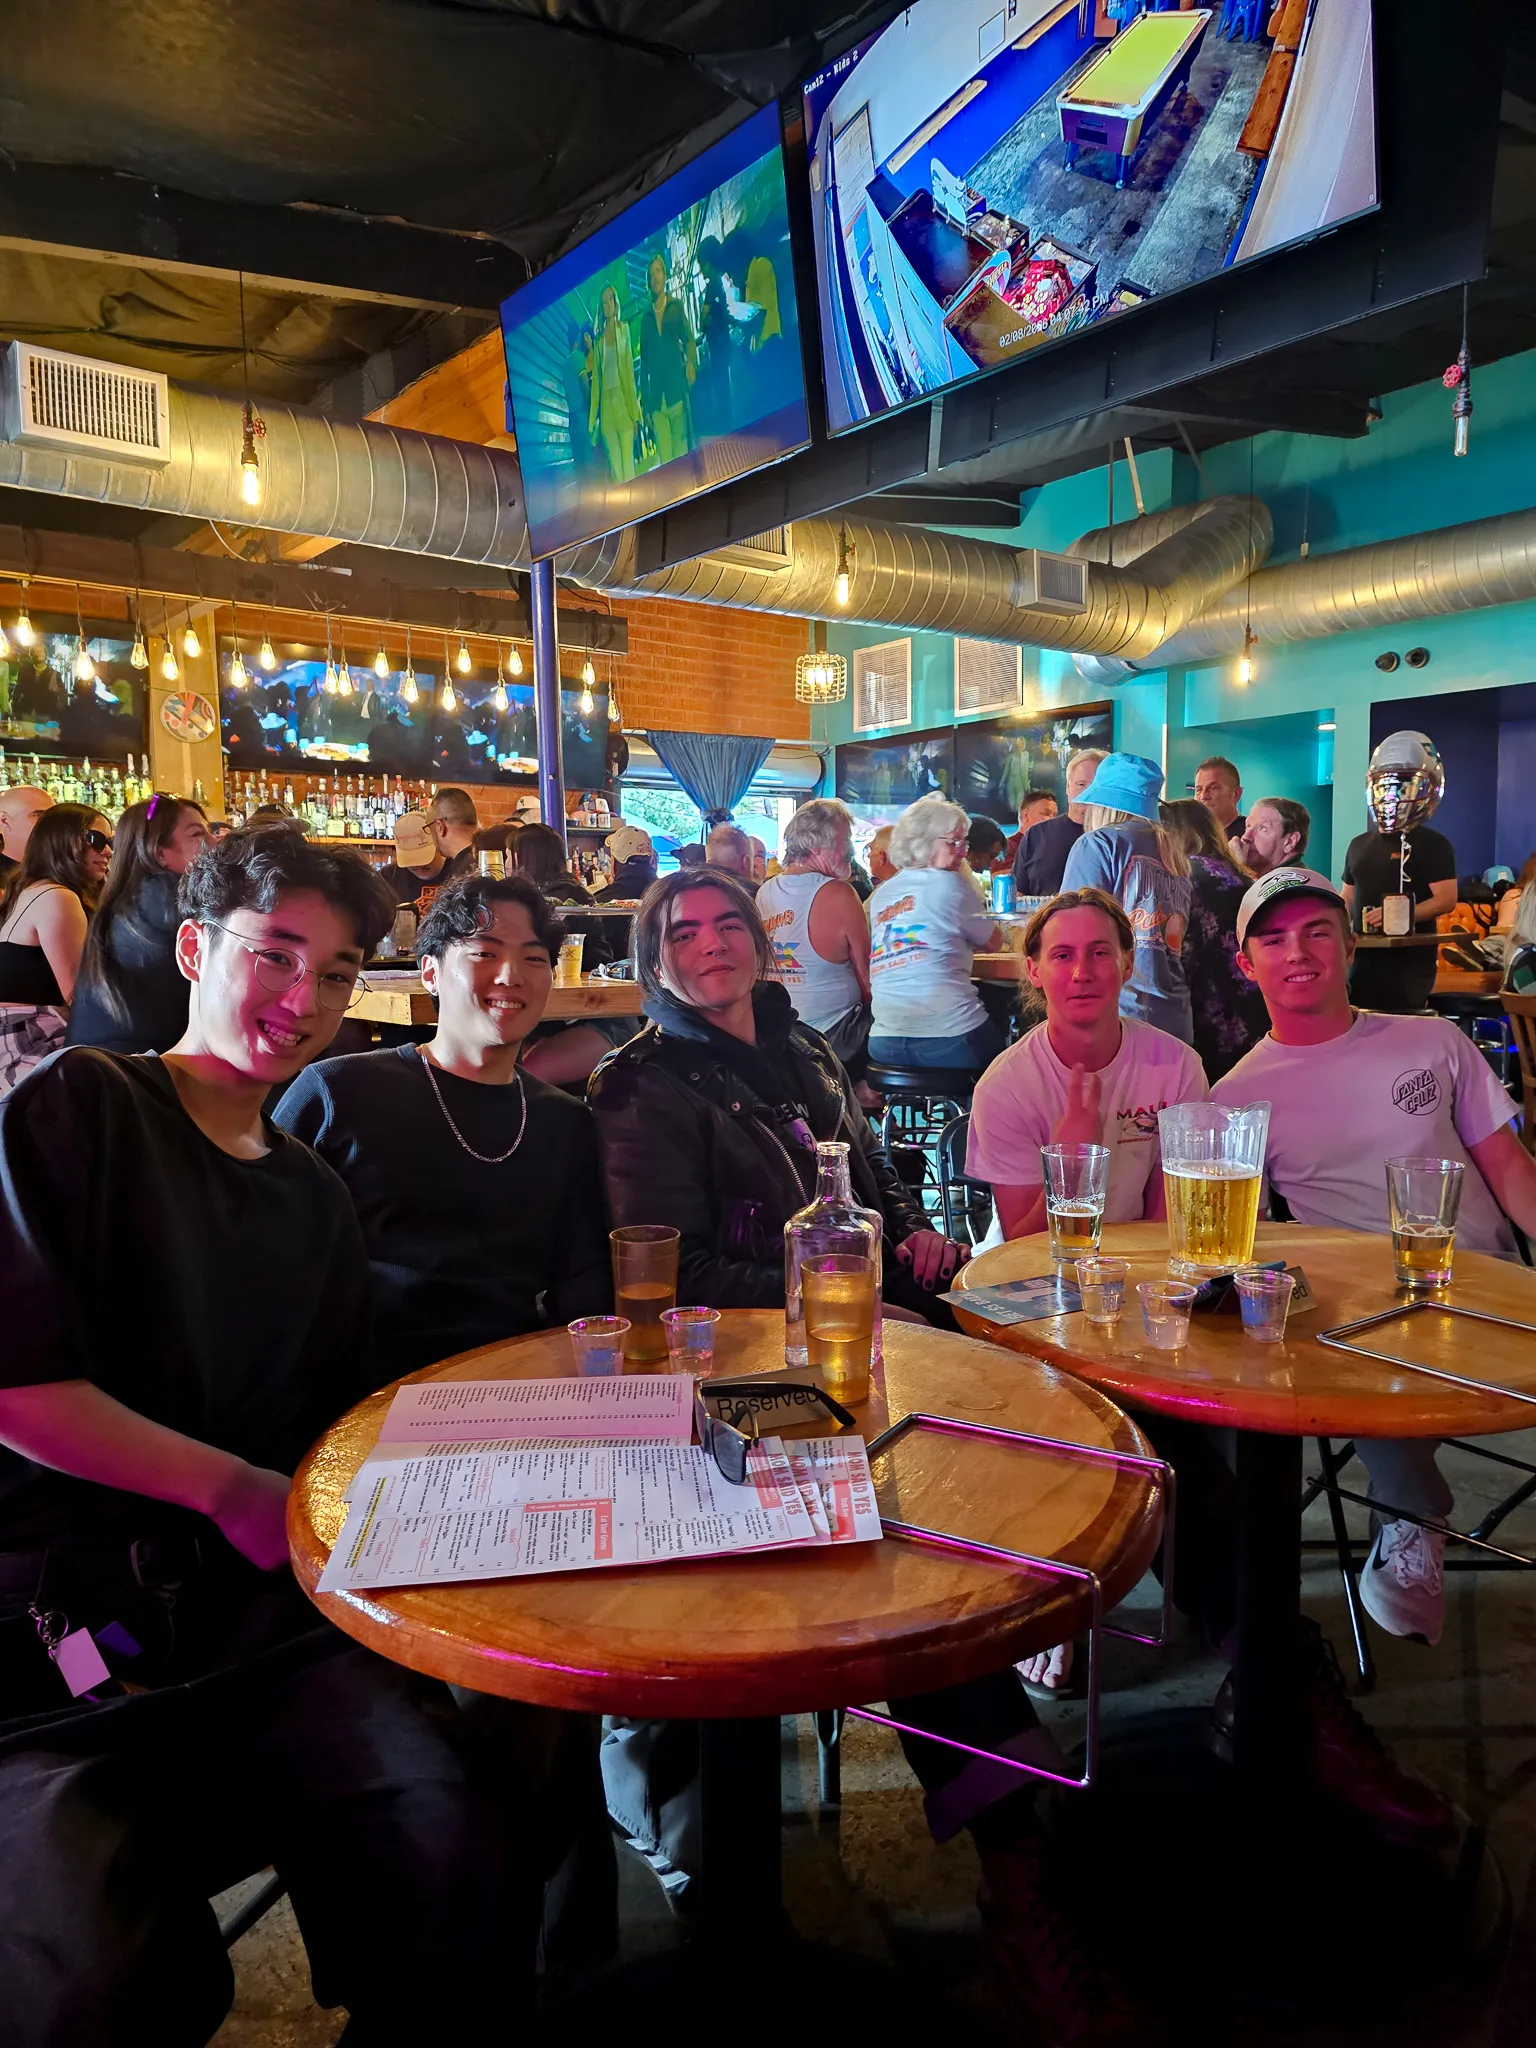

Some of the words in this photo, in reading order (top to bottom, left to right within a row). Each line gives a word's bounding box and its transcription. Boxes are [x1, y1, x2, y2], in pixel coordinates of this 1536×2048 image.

[833, 57, 851, 75] Kids
[852, 49, 859, 62] 2
[1092, 290, 1110, 310] PM
[786, 976, 802, 984] YES
[1393, 1069, 1435, 1106] SANTA
[1405, 1083, 1437, 1115] CRUZ
[767, 1453, 789, 1476] MOM
[788, 1455, 808, 1478] MOM
[847, 1451, 865, 1473] MOM
[775, 1475, 797, 1497] SAID
[850, 1472, 868, 1493] SAID
[784, 1497, 804, 1516] YES
[854, 1495, 872, 1515] YES
[599, 1514, 608, 1523] Eat
[599, 1522, 609, 1534] Your
[726, 1524, 736, 1537] Toppings
[599, 1533, 609, 1551] Greens
